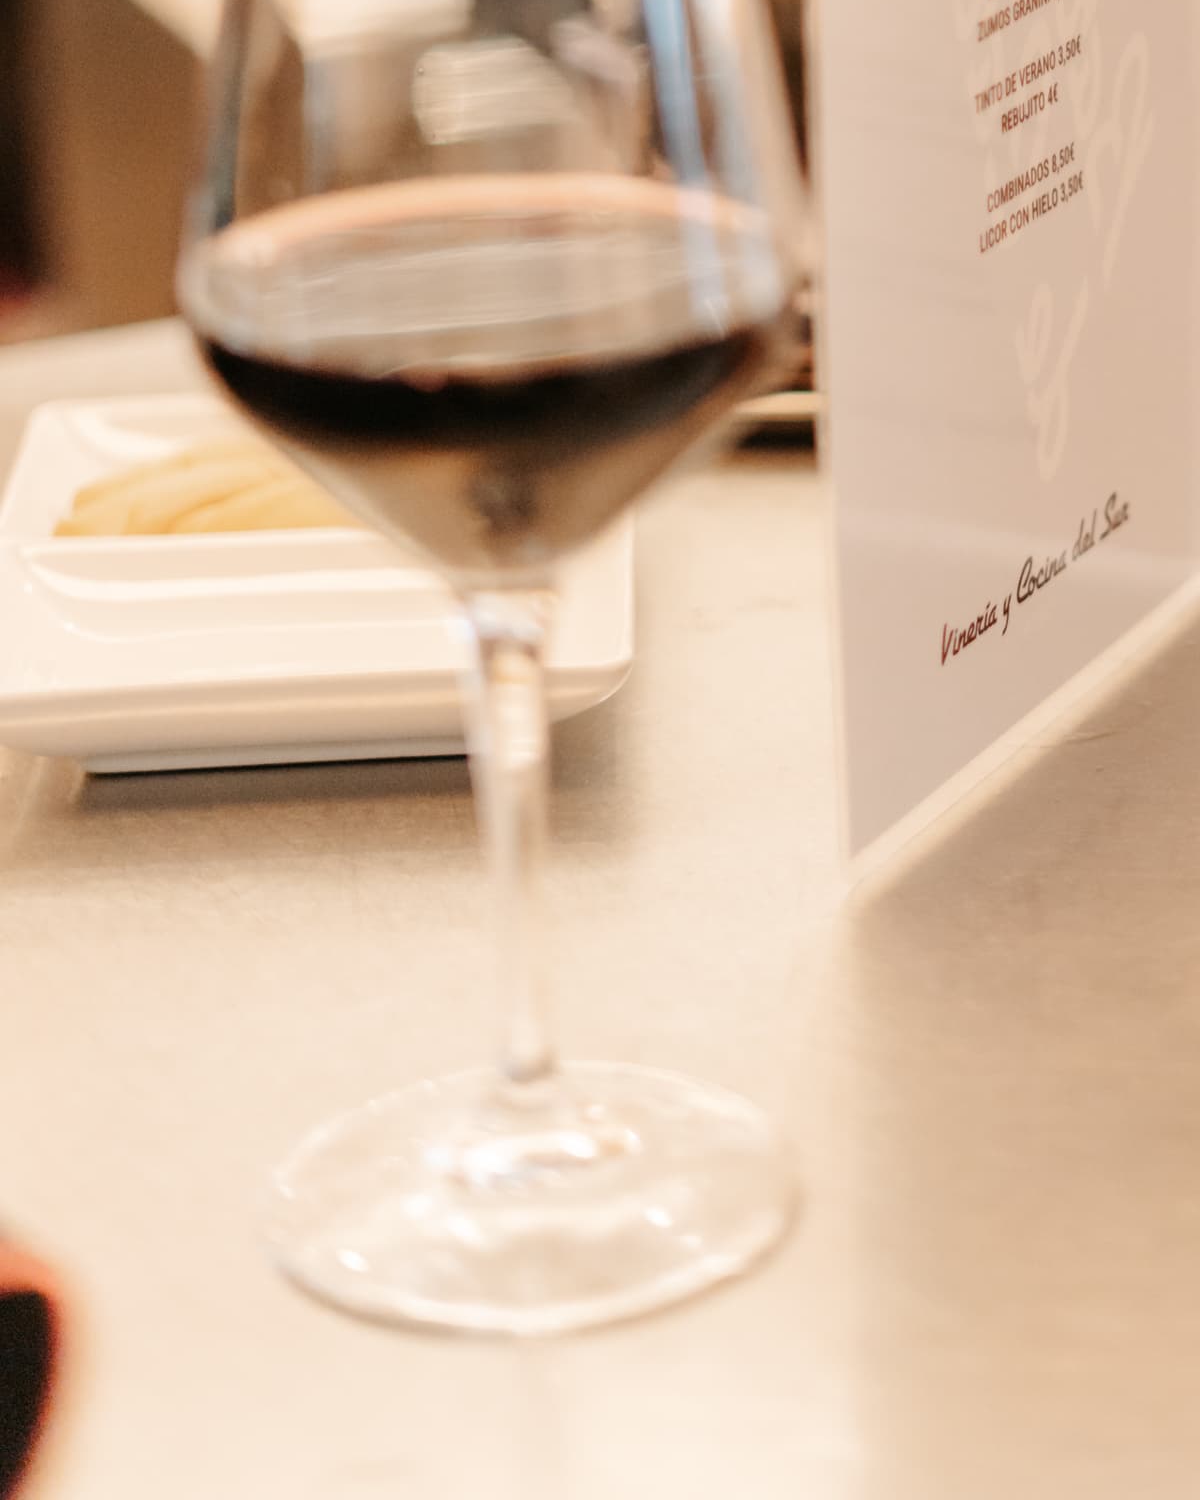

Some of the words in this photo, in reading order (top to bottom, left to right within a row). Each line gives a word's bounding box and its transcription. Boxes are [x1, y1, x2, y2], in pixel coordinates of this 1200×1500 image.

[977, 6, 1011, 42] ZUMOS
[975, 81, 1003, 111] TINTO
[1004, 72, 1017, 97] DE
[1018, 50, 1056, 87] VERANO
[1057, 34, 1081, 66] 3,50€
[1001, 91, 1045, 133] REBUJITO
[1047, 82, 1058, 104] 4€
[979, 219, 1007, 253] LICOR
[1009, 206, 1029, 234] CON
[1031, 187, 1058, 220] HIELO
[1060, 170, 1083, 202] 3,50€
[987, 158, 1050, 213] COMBINADOS
[1051, 141, 1075, 173] 8,50€
[1002, 593, 1012, 636] y
[1016, 551, 1067, 604] Cocina
[1072, 508, 1097, 561] del
[1099, 491, 1129, 540] Sur
